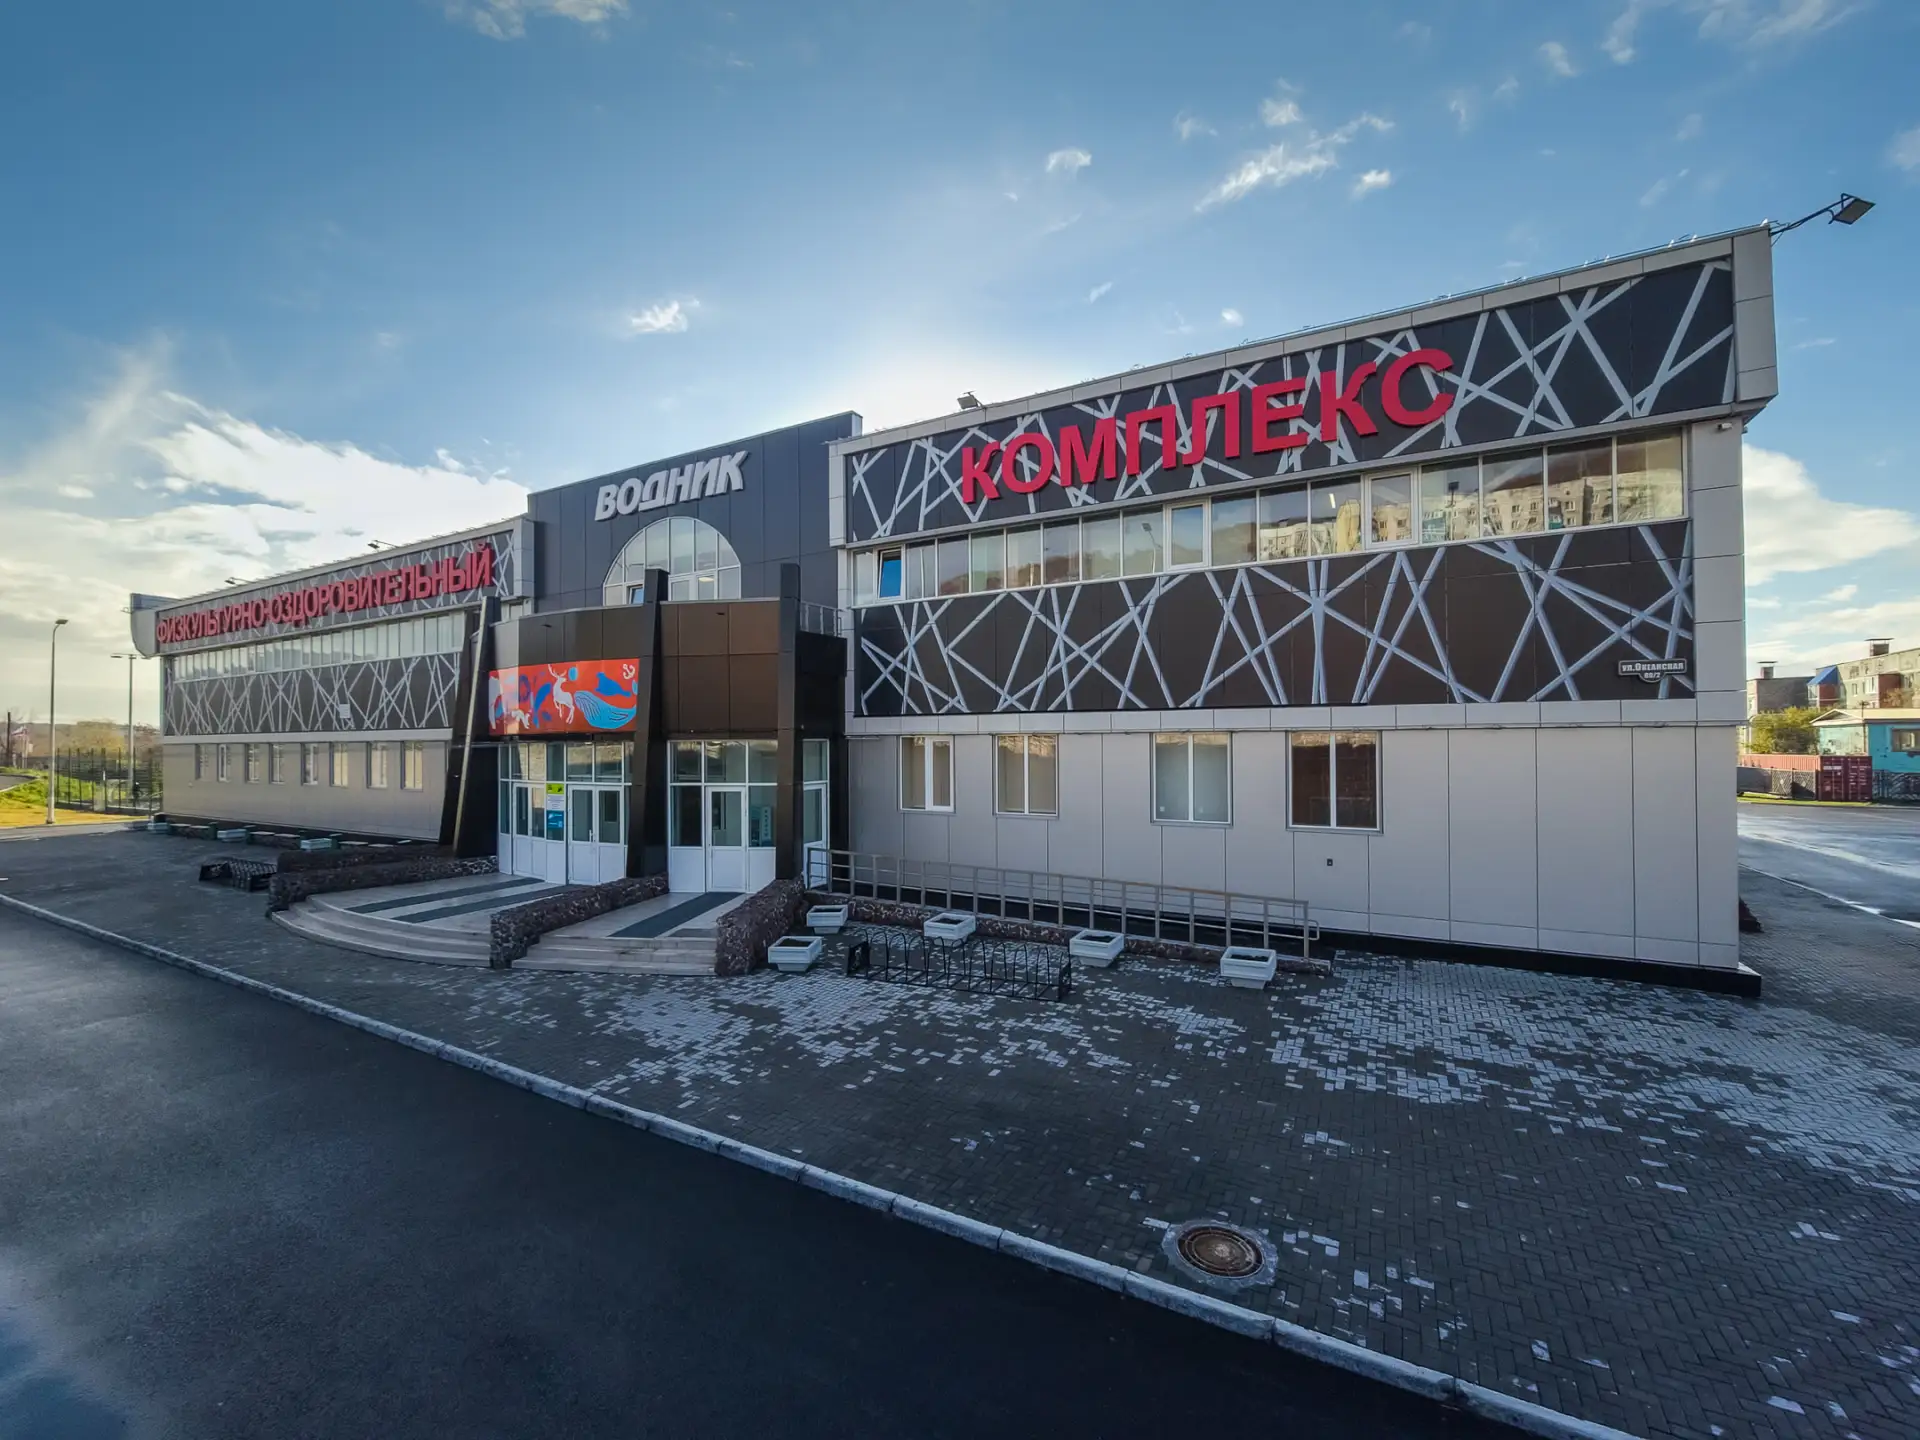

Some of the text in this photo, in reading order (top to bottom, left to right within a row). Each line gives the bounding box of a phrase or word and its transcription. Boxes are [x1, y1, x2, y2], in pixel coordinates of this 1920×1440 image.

[961, 348, 1455, 503] КОМПЛЕКС
[594, 450, 749, 522] ВОДНИК
[156, 542, 496, 645] ФИЗКУЛЬТУРНО-ОЗДОРОВИТЕЛЬНЫЙ
